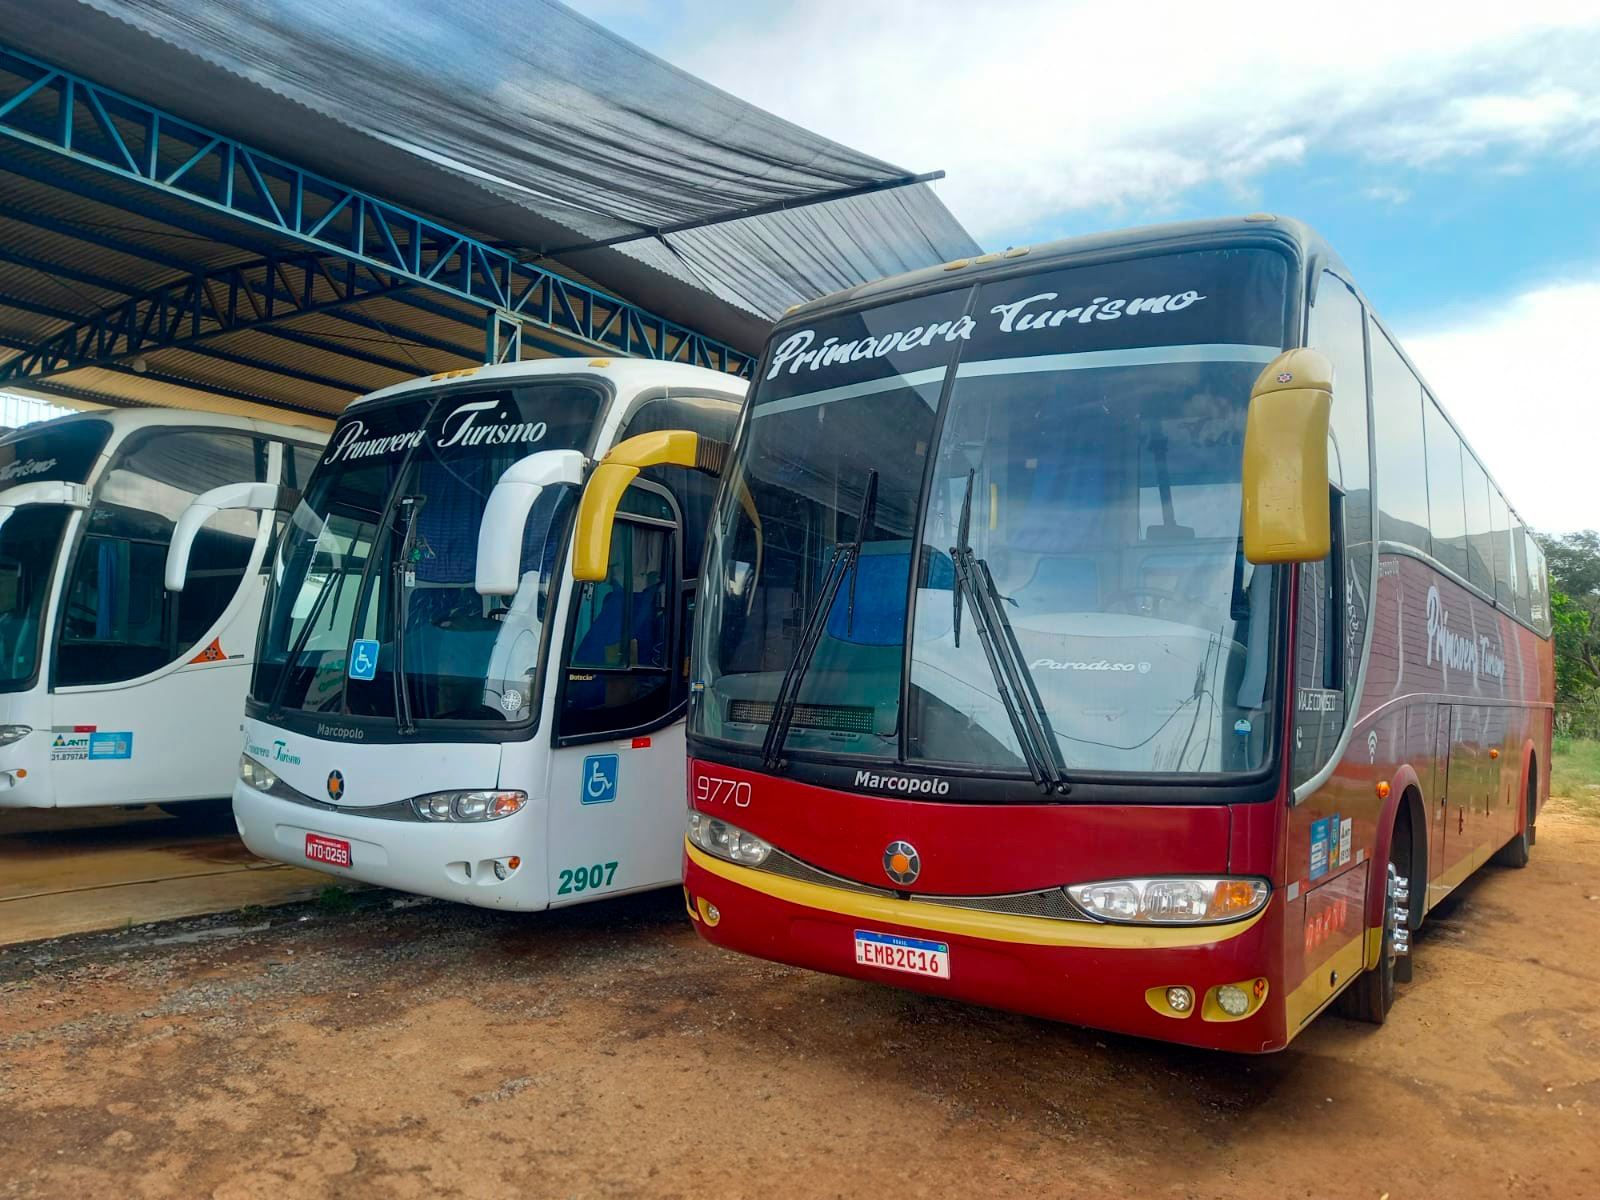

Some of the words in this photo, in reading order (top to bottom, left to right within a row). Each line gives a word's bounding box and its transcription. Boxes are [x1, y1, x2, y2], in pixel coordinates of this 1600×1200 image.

[766, 315, 976, 381] Primavera
[991, 290, 1206, 333] Turismo
[324, 420, 427, 465] Primavera
[437, 400, 547, 448] Turismo
[1030, 658, 1135, 671] Paradiso
[317, 722, 364, 739] Marcopolo
[697, 775, 752, 807] 9770
[854, 770, 950, 795] Marcopolo
[557, 860, 619, 895] 2907
[863, 943, 939, 974] EMB2C16
